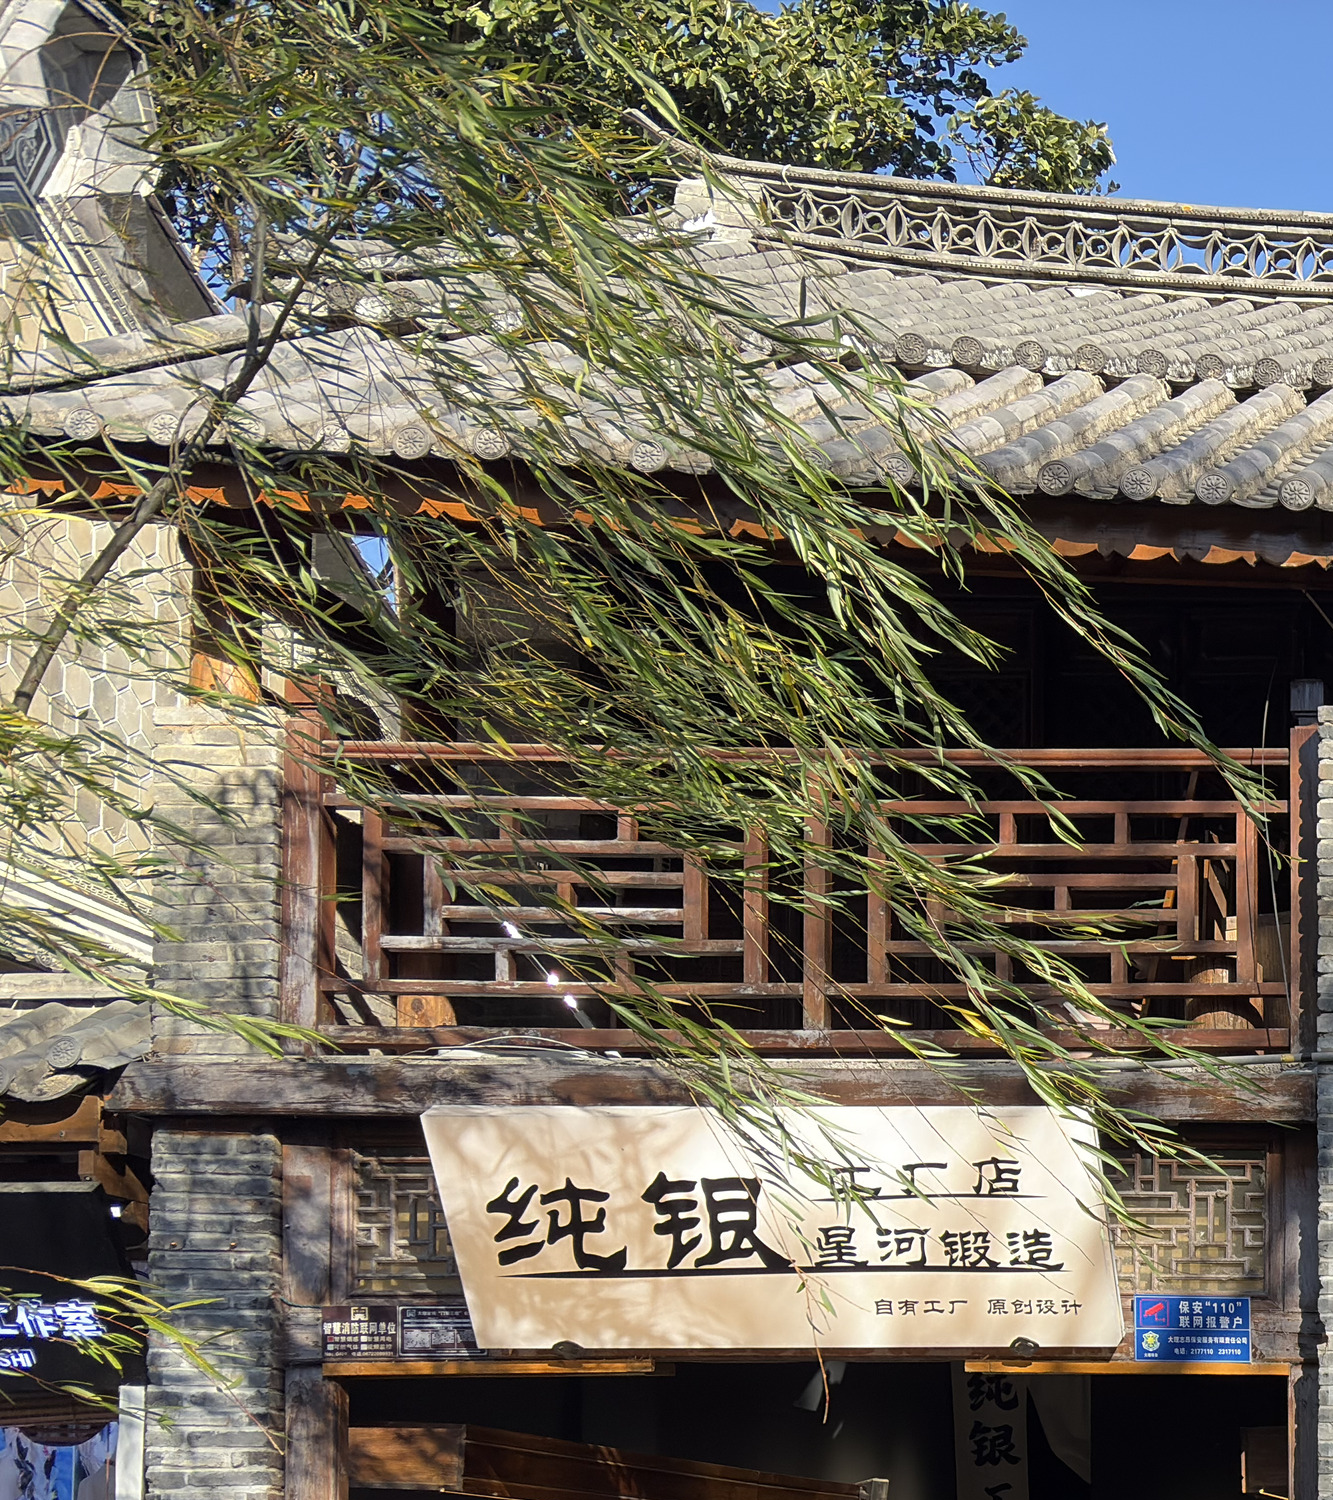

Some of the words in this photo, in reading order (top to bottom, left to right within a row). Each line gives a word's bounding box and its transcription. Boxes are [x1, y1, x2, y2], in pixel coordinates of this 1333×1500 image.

[829, 1156, 1021, 1195] 工厂店
[486, 1171, 793, 1270] 纯银
[813, 1226, 1064, 1272] 星河锻造
[874, 1298, 968, 1316] 自有工厂
[987, 1298, 1083, 1316] 原创设计
[323, 1322, 397, 1335] 智慧消防联网单位
[1179, 1315, 1243, 1329] 联网报警户
